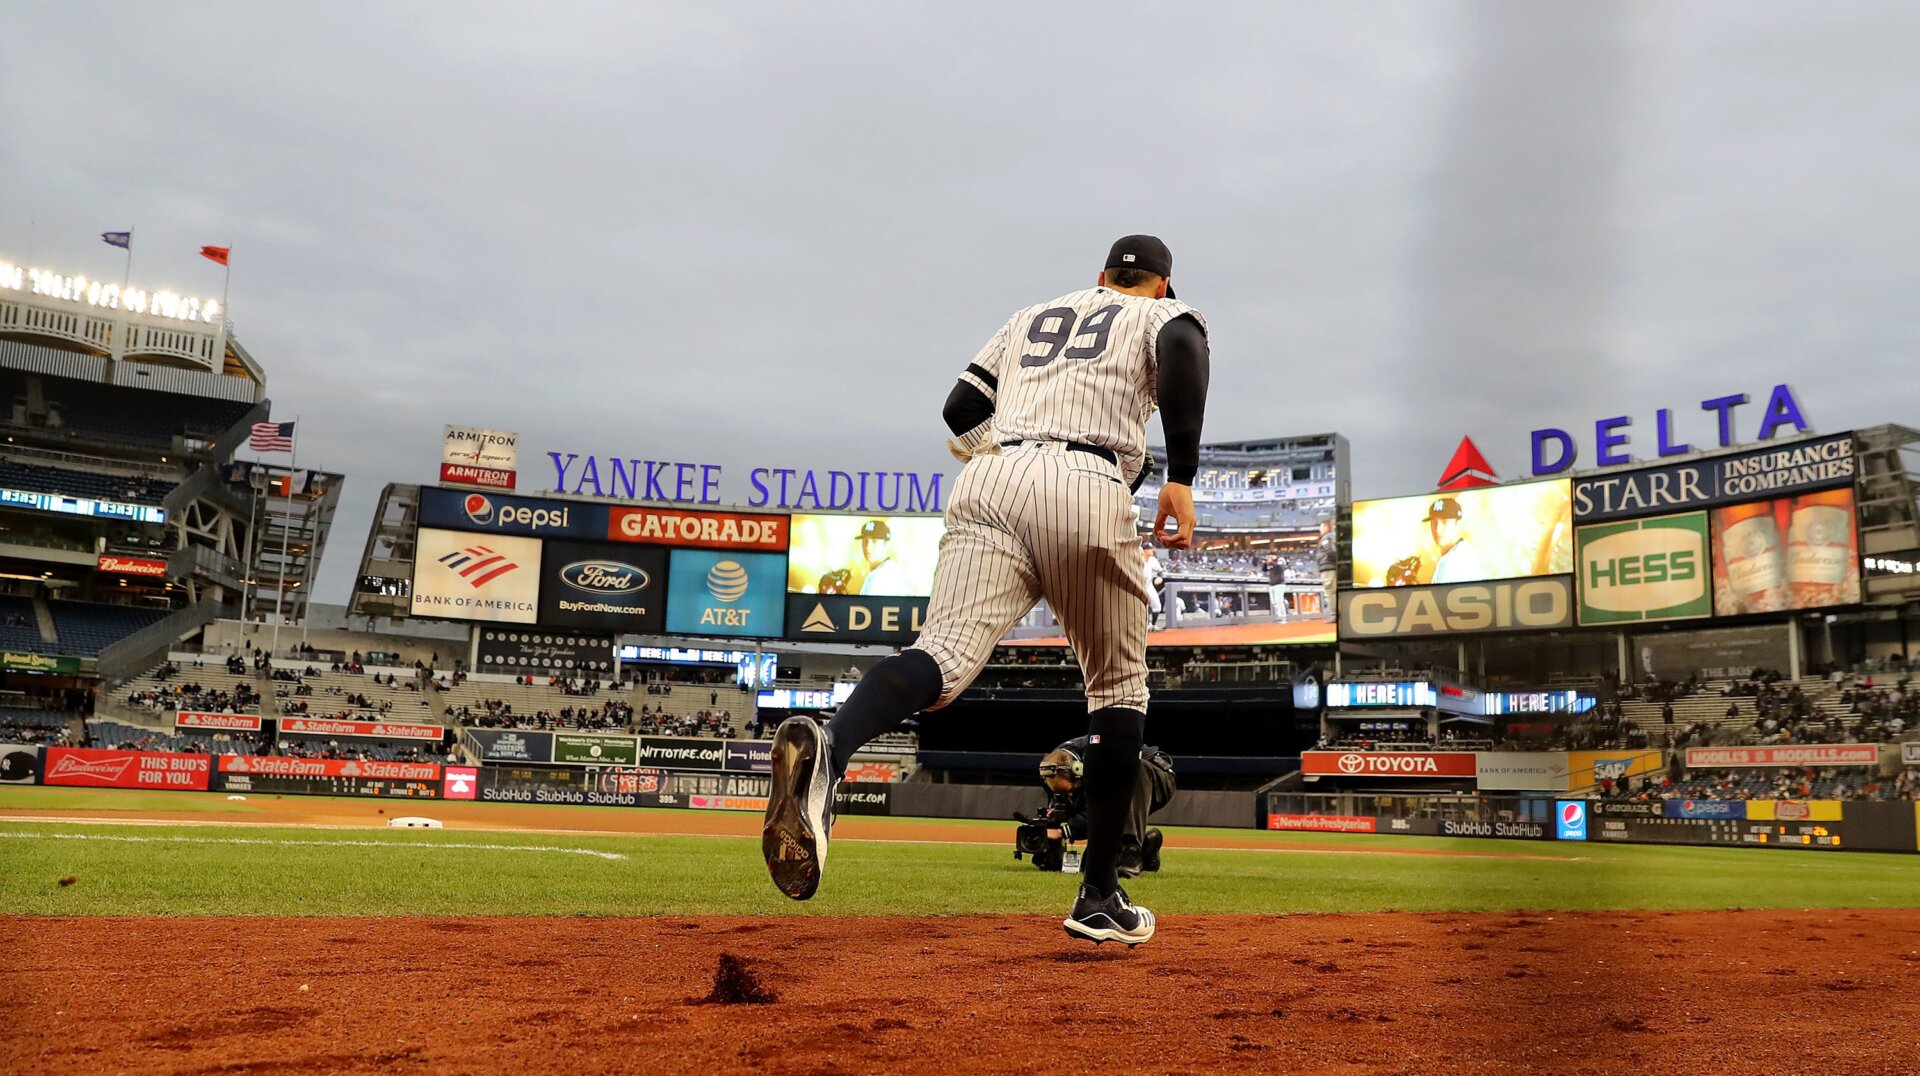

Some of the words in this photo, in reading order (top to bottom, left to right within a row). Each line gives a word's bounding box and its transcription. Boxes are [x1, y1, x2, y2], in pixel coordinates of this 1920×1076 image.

[1020, 304, 1124, 368] 99
[446, 430, 515, 446] ARMITRON
[1531, 383, 1810, 476] DELTA
[1723, 438, 1853, 479] INSURANCE
[446, 466, 511, 481] ARMITRON
[547, 451, 722, 504] YANKEE
[748, 467, 944, 513] STADIUM
[1723, 457, 1854, 497] COMPANIES
[1574, 467, 1710, 516] STARR
[498, 505, 569, 530] pepsi
[620, 513, 778, 544] GATORADE
[98, 557, 165, 575] Budweiser
[1590, 549, 1696, 589] HESS
[576, 564, 632, 590] Ford
[415, 594, 451, 605] BANK
[456, 597, 472, 607] OF
[475, 600, 534, 612] AMERICA
[559, 600, 646, 615] BuyFordNow.com
[1349, 580, 1568, 635] CASIO
[700, 608, 751, 626] AT&T
[848, 605, 925, 632] DEL
[795, 691, 830, 707] HERE
[1356, 684, 1396, 704] HERE
[1509, 693, 1549, 712] HERE
[640, 745, 723, 762] NITTOTIRE.COM
[749, 750, 772, 761] Hotel
[56, 757, 124, 773] Budweiser
[140, 756, 168, 770] THIS
[170, 757, 207, 772] BUD'S
[1366, 756, 1438, 772] TOYOTA
[1595, 762, 1625, 779] SAP
[138, 771, 163, 783] FOR
[166, 772, 194, 785] YOU.
[483, 788, 532, 801] StubHub
[536, 790, 583, 803] StubHub
[587, 792, 635, 805] StubHub
[658, 795, 673, 804] 399
[724, 797, 768, 808] DUNKI
[835, 792, 886, 804] OTIRE.COM
[1605, 804, 1650, 813] GATORADE
[1695, 803, 1729, 815] pepsi
[1391, 819, 1406, 829] 385
[1444, 821, 1491, 835] StubHub
[1495, 823, 1543, 837] StubHub
[780, 830, 809, 859] adidas
